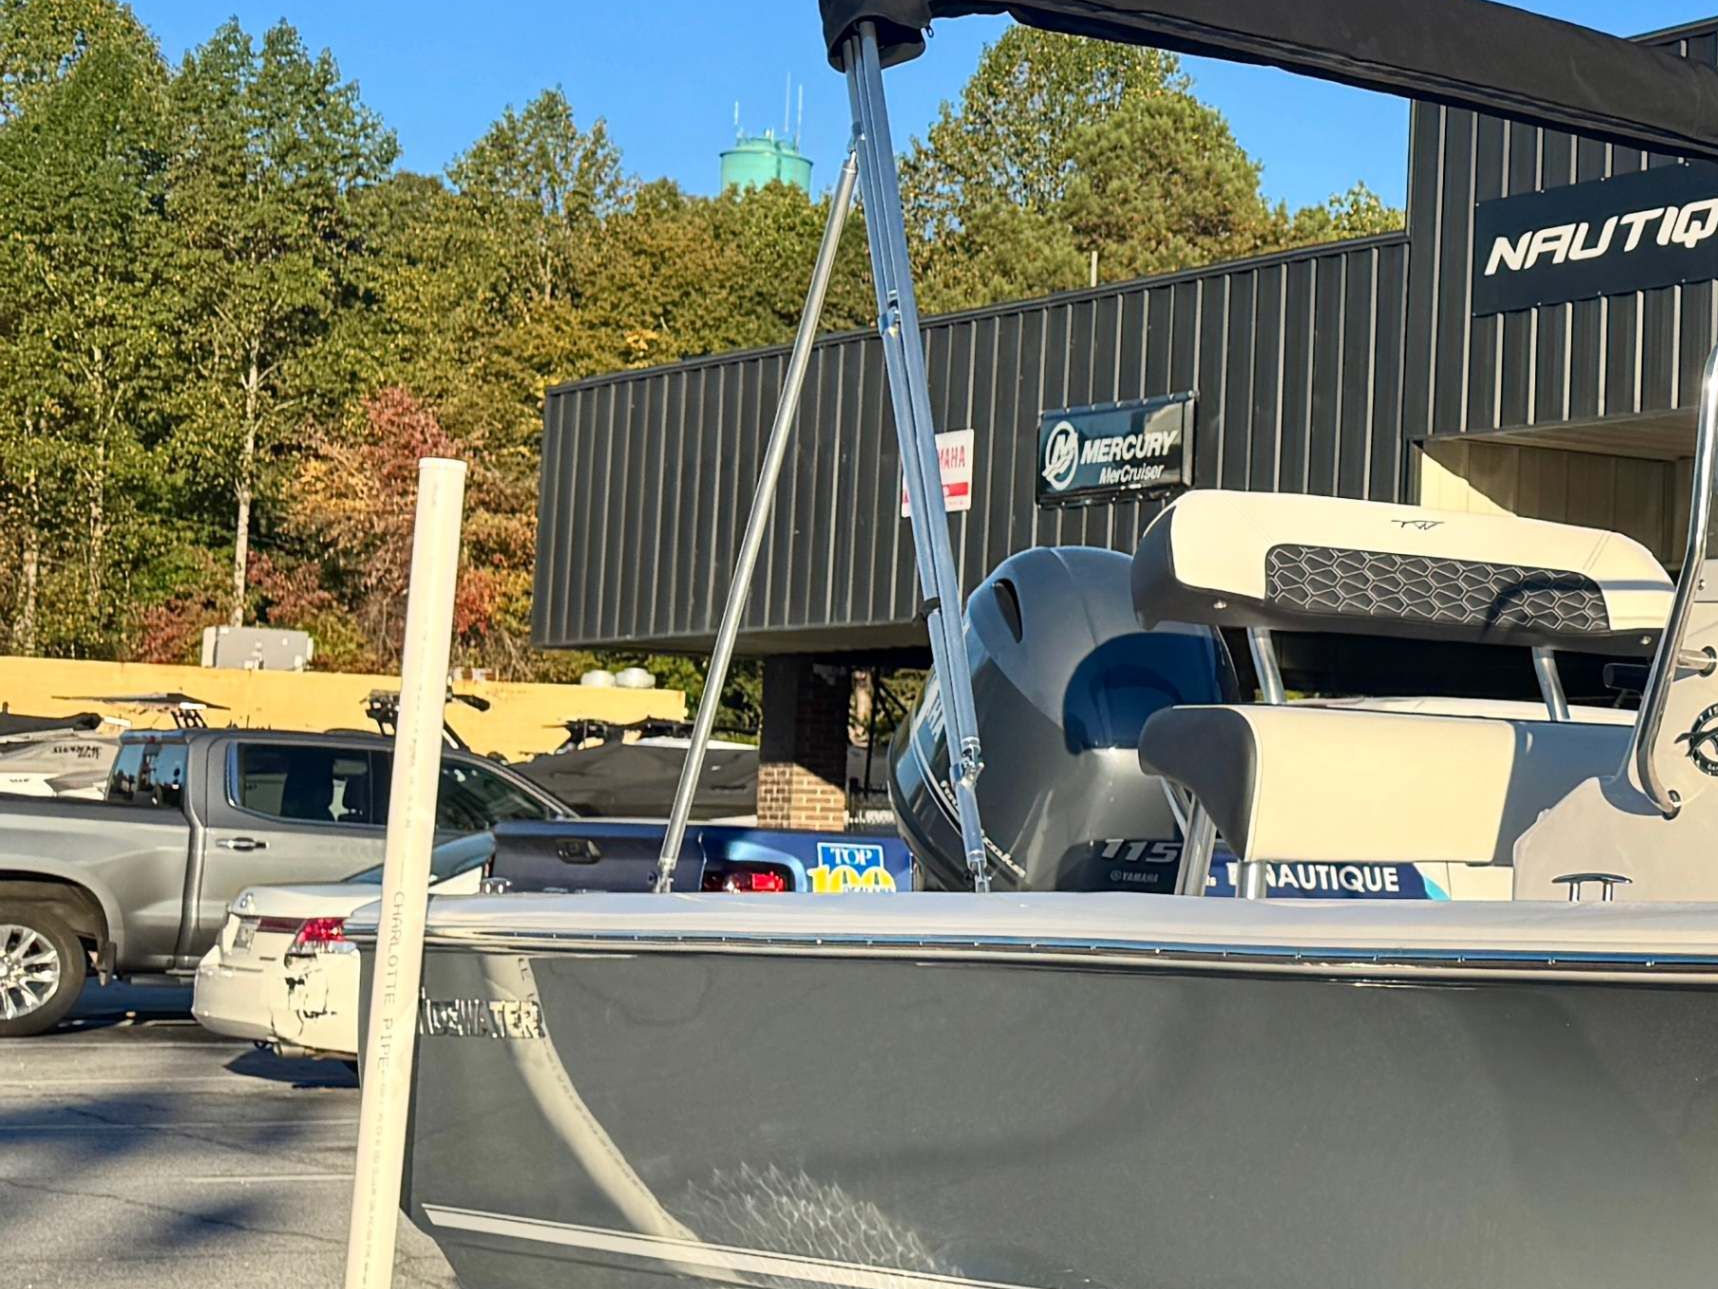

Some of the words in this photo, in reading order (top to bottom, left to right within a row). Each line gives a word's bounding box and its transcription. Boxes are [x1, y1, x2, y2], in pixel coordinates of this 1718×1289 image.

[1080, 430, 1179, 465] MERCURY
[1099, 463, 1165, 485] MerCruiser
[830, 847, 873, 866] TOP
[1102, 838, 1183, 863] 115
[807, 865, 897, 893] 100
[1122, 870, 1159, 884] YAMAHA
[1264, 864, 1401, 893] NAUTIQUE
[383, 891, 405, 1006] CHARLOTTE
